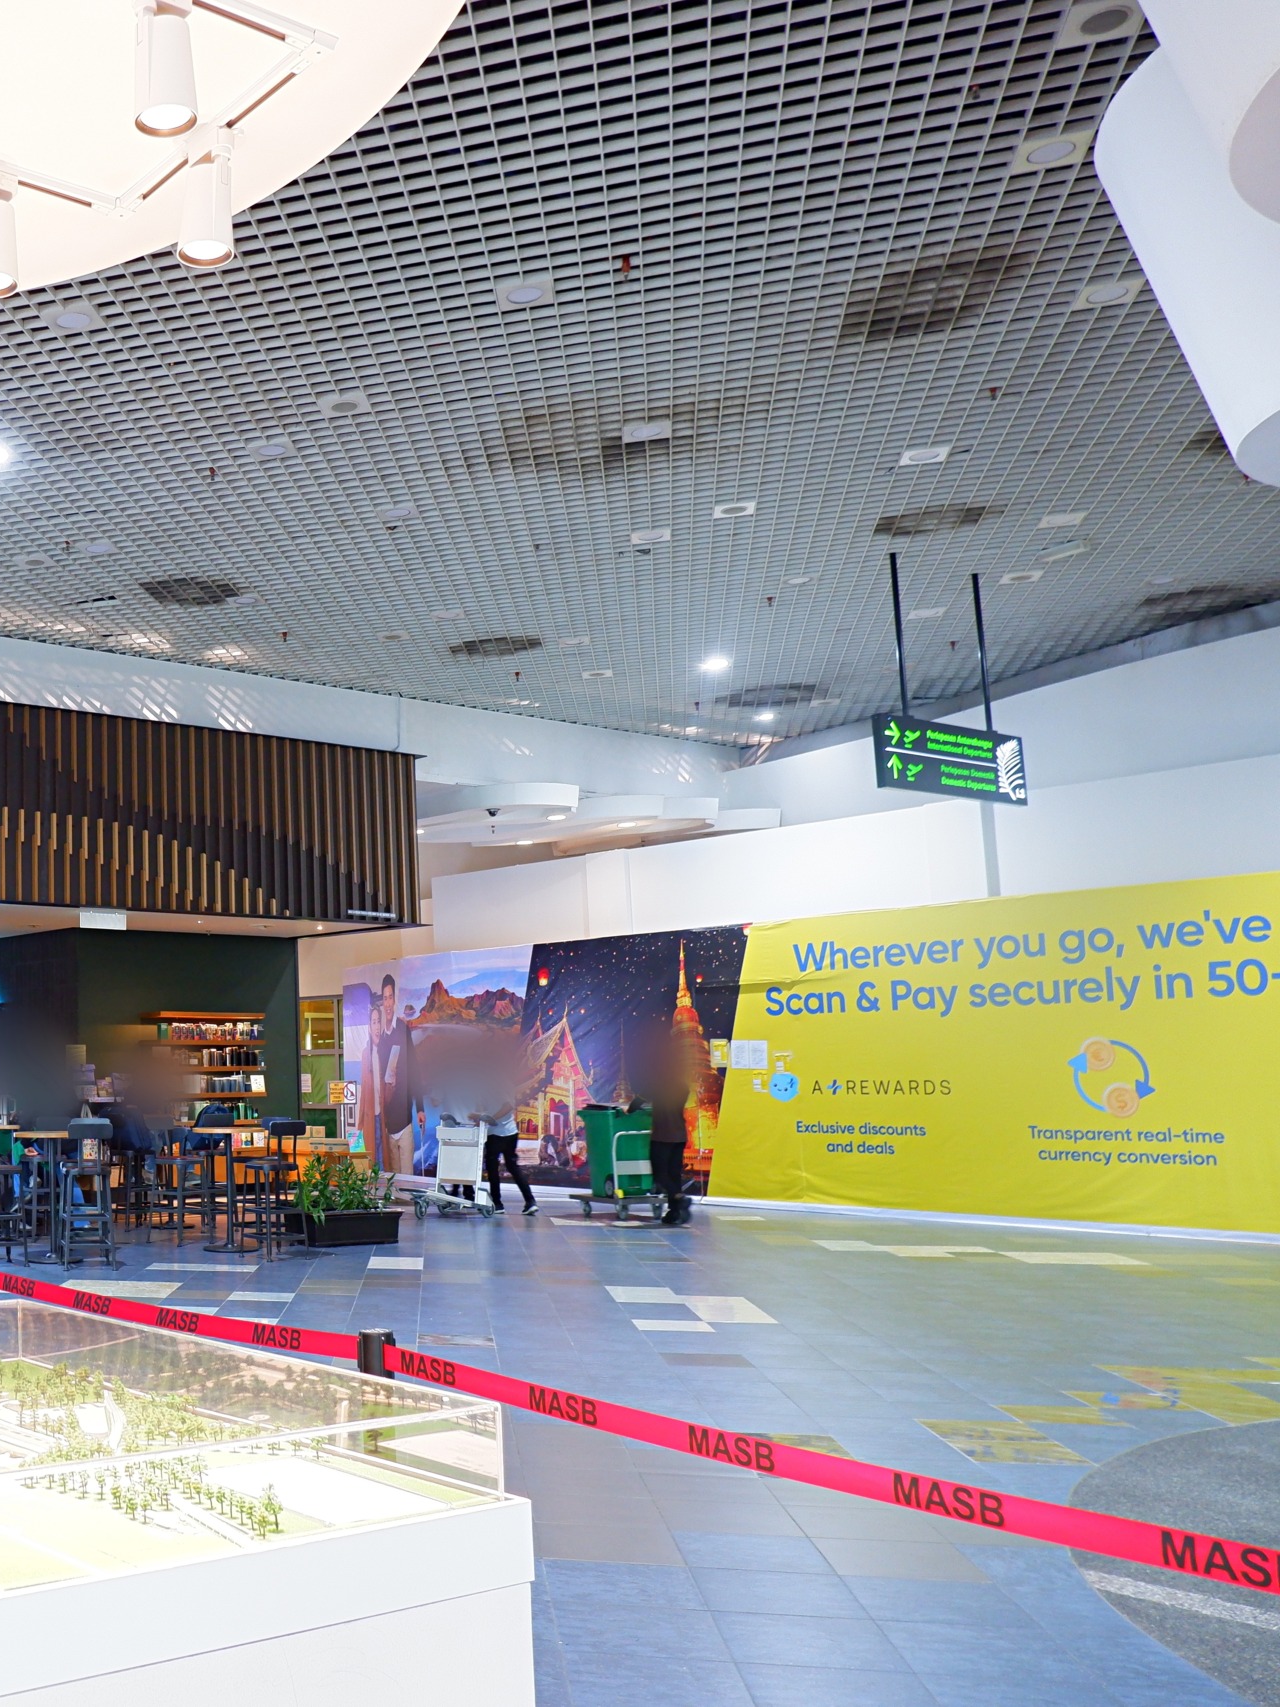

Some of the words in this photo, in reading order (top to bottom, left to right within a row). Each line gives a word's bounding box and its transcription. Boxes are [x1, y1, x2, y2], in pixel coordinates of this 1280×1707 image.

[792, 939, 965, 973] Wherever
[974, 930, 1047, 969] you
[1058, 925, 1125, 965] go,
[1136, 909, 1273, 950] we've
[765, 986, 847, 1017] Scan
[856, 980, 882, 1013] &
[890, 979, 959, 1018] Pay
[969, 963, 1141, 1012] securely
[1153, 963, 1194, 1001] in
[796, 1120, 856, 1135] Exclusive
[858, 1122, 927, 1137] discounts
[1028, 1125, 1132, 1144] Transparent
[1137, 1127, 1225, 1144] real-time
[826, 1141, 854, 1154] and
[856, 1141, 896, 1156] deals
[1038, 1149, 1113, 1166] currency
[1117, 1150, 1218, 1166] conversion
[1, 1274, 36, 1298] MASB
[73, 1291, 111, 1316] MASB
[156, 1308, 199, 1333] MASB
[251, 1323, 302, 1351] MASB
[401, 1351, 456, 1386] MASB
[529, 1385, 597, 1424] MASB
[688, 1424, 775, 1473] MASB
[893, 1472, 1005, 1527] MASB
[1161, 1530, 1280, 1589] MAS
